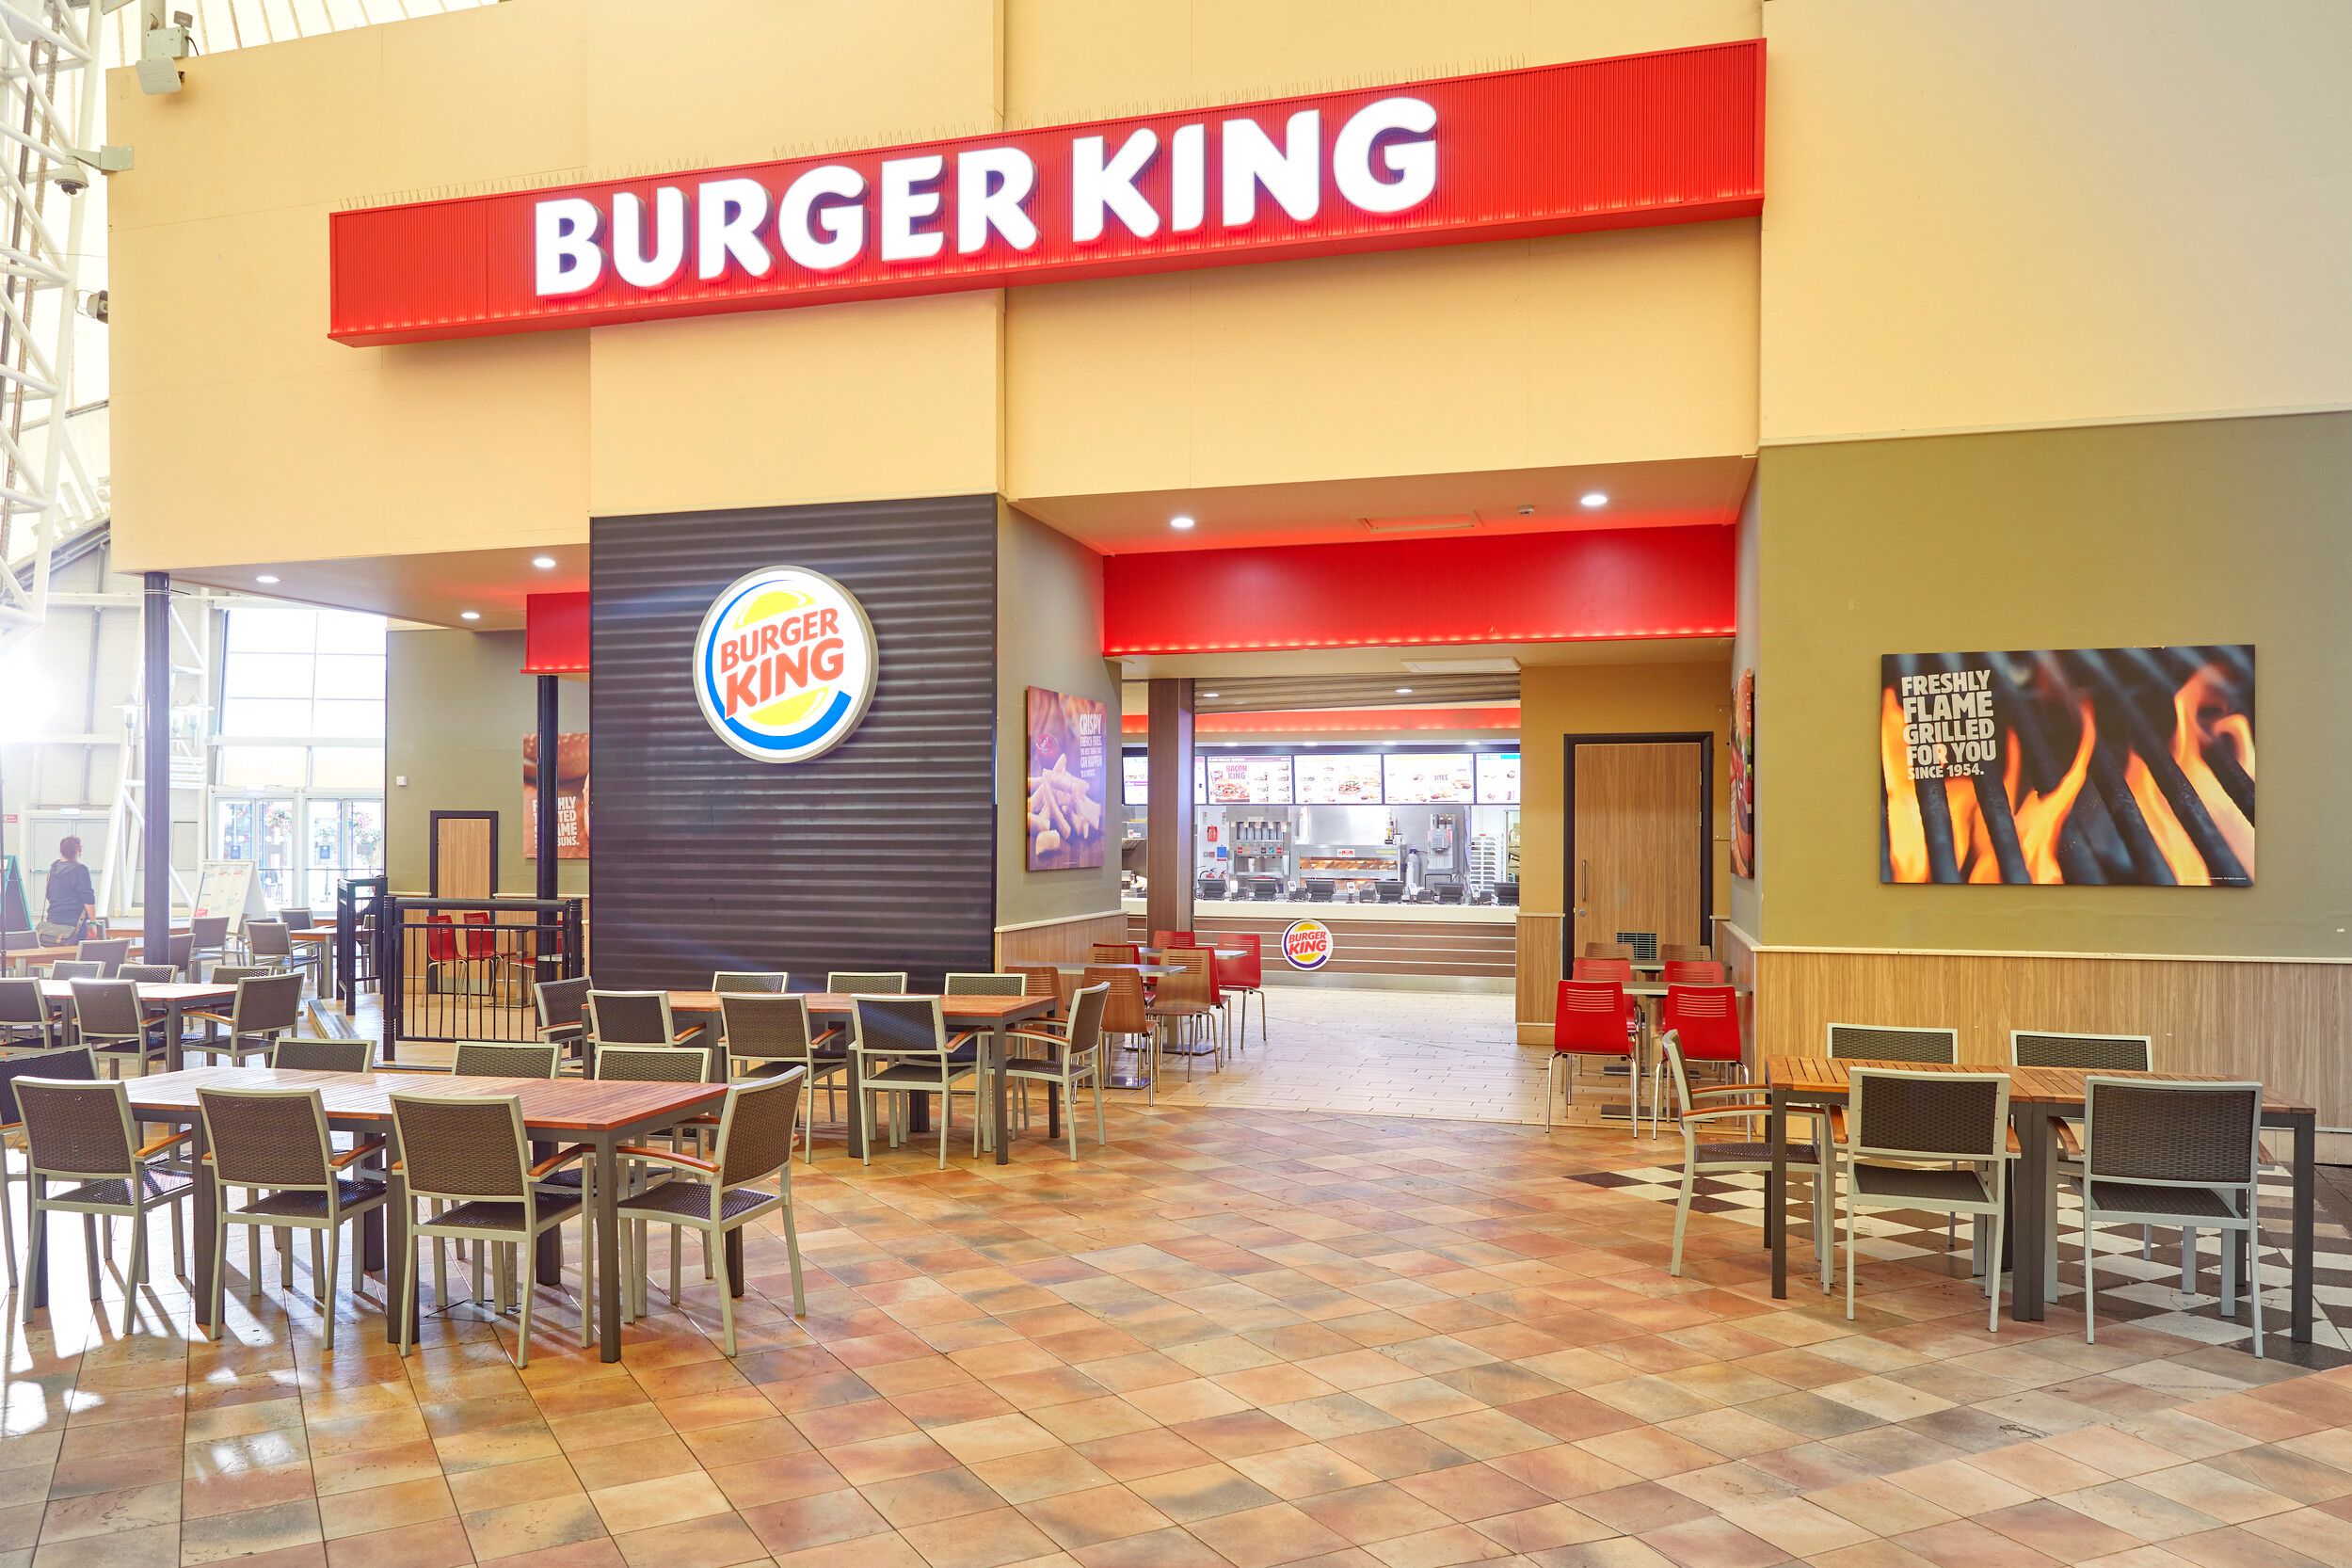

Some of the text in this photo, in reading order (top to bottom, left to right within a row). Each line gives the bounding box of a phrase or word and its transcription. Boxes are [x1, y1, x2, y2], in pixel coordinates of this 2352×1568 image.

[535, 96, 1439, 297] BURGER KING
[721, 607, 840, 675] BURGER
[725, 637, 844, 718] KING
[1901, 669, 1992, 696] FRESHLY
[1902, 690, 1994, 724] FLAME
[1080, 713, 1102, 735] CRISPY
[1902, 717, 1995, 745] GRILLED
[1906, 740, 1997, 767] FOR YOU
[1907, 763, 1985, 781] SINCE 1954.
[1288, 931, 1327, 944] BURGER
[1288, 939, 1327, 956] KING
